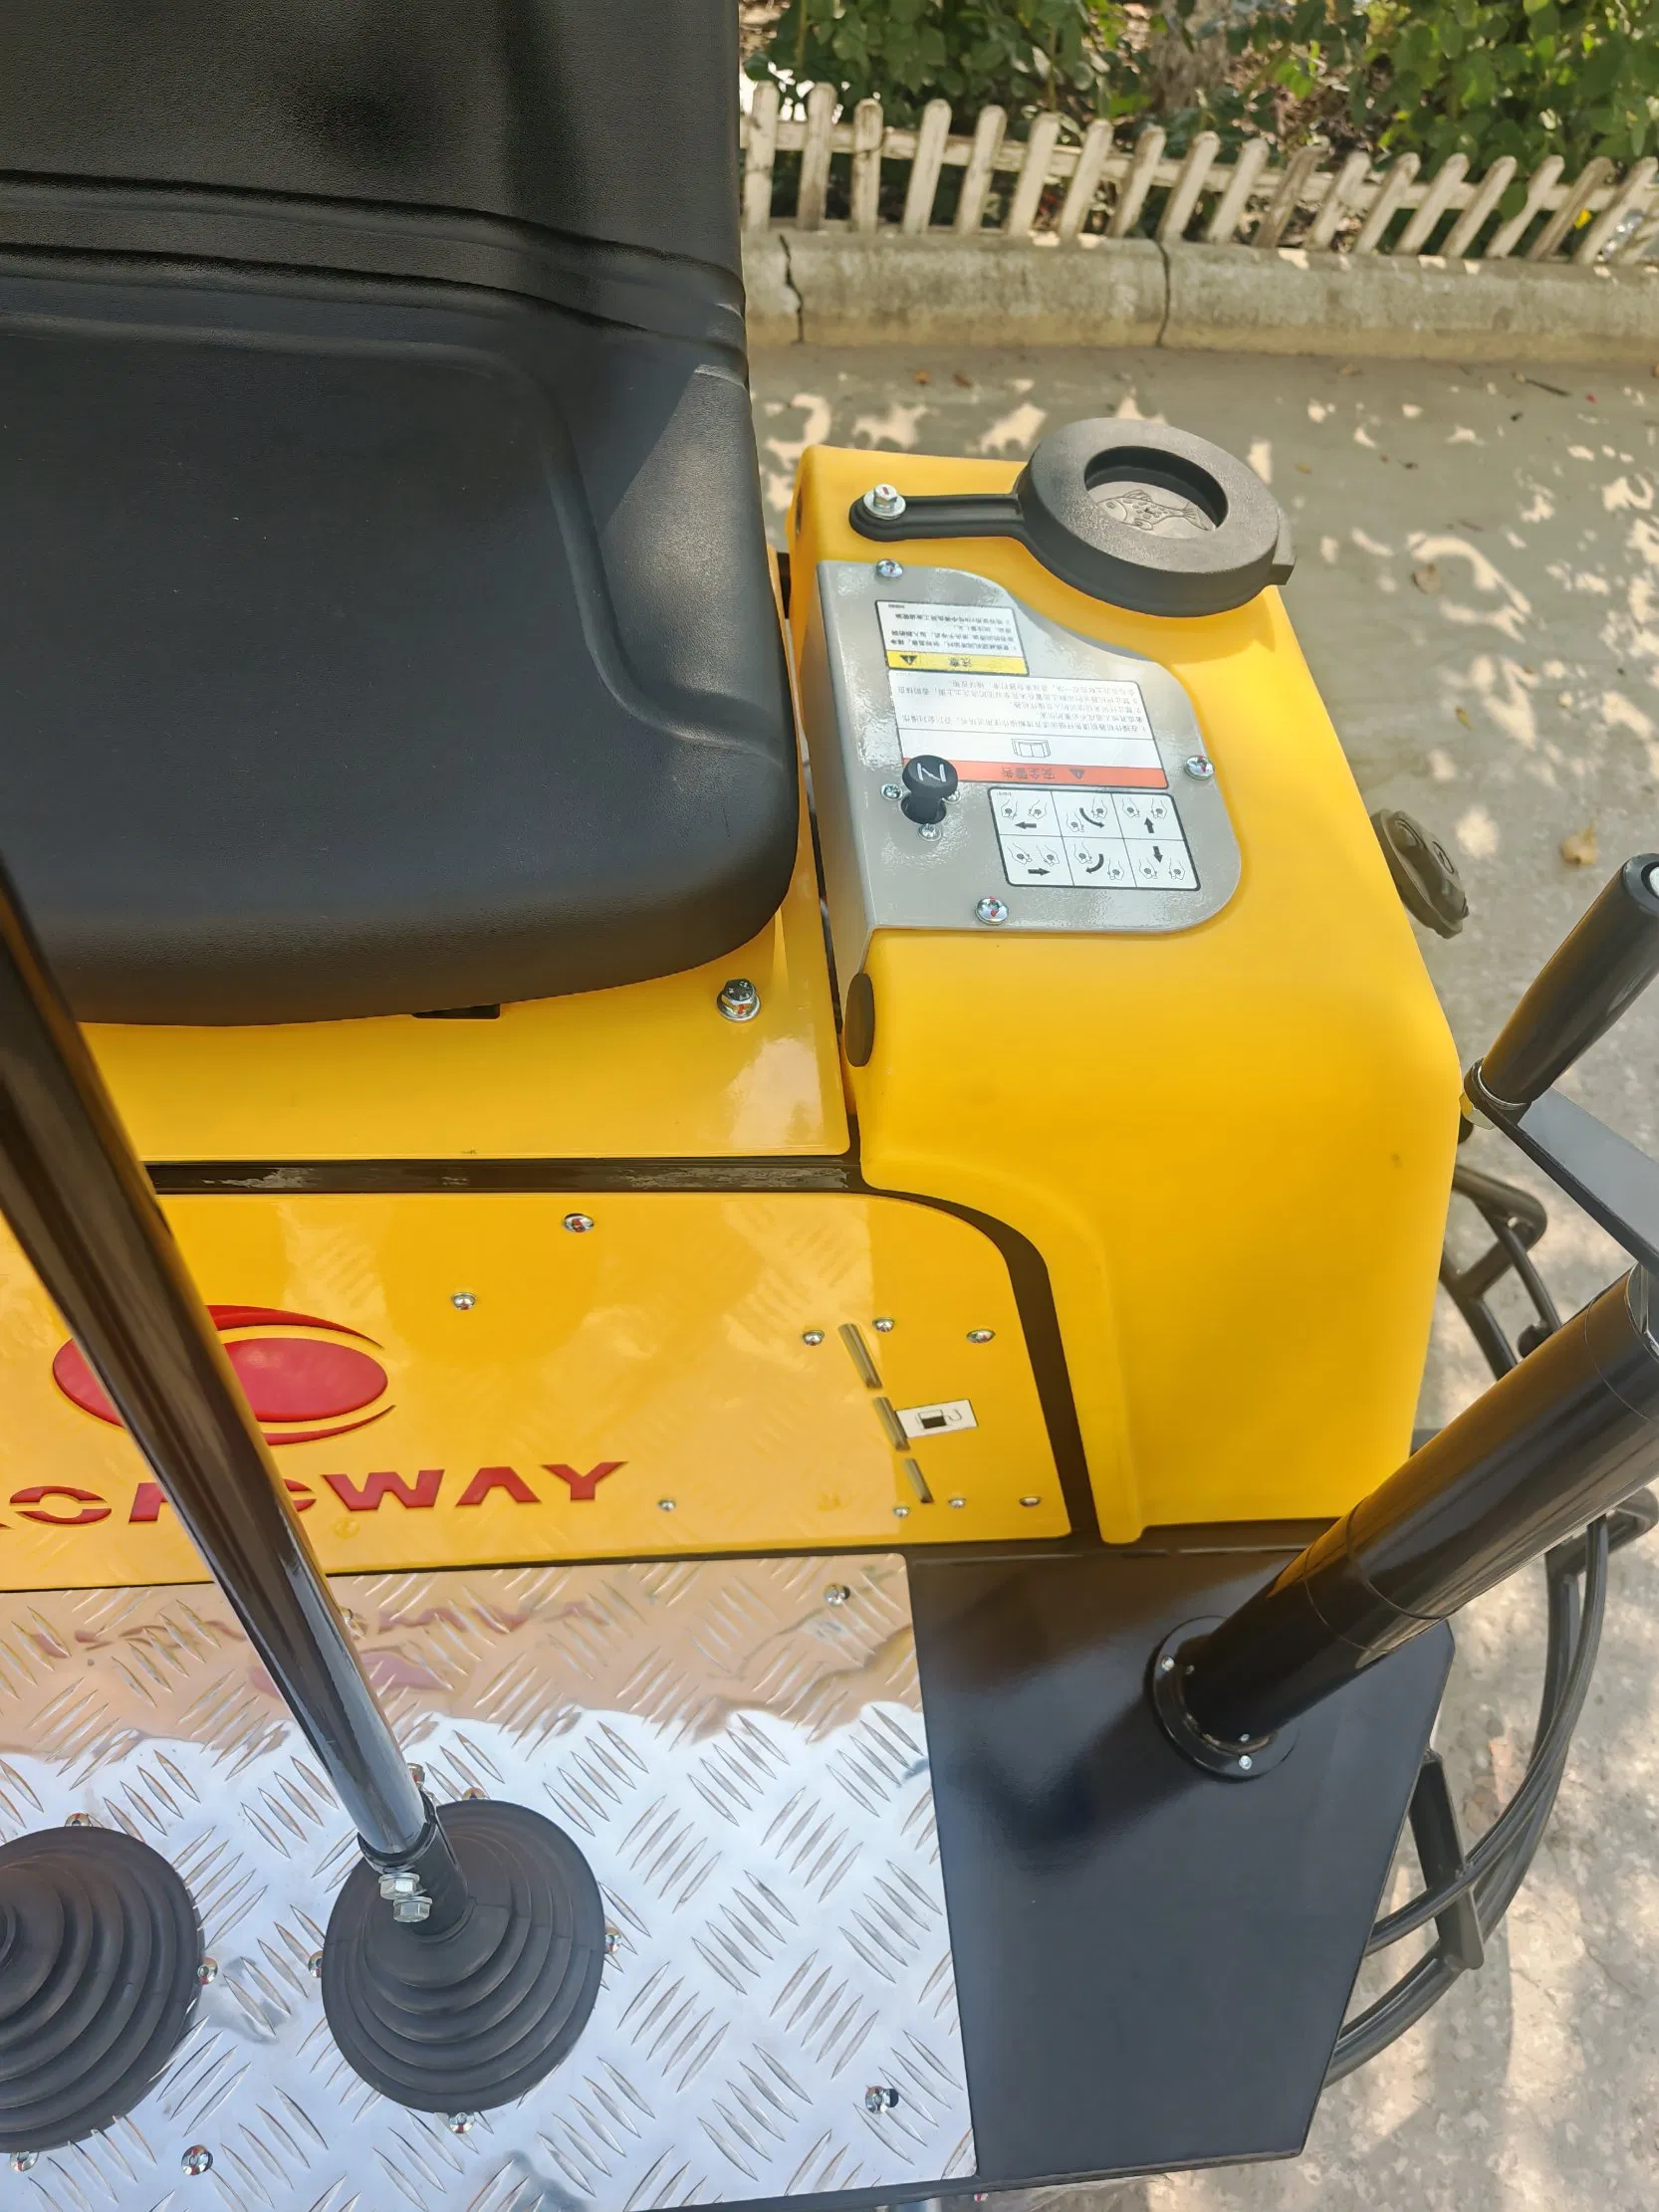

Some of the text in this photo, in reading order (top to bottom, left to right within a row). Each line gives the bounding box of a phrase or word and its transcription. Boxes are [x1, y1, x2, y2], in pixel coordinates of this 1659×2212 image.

[916, 763, 947, 782] N
[1001, 767, 1057, 779] 安全警告
